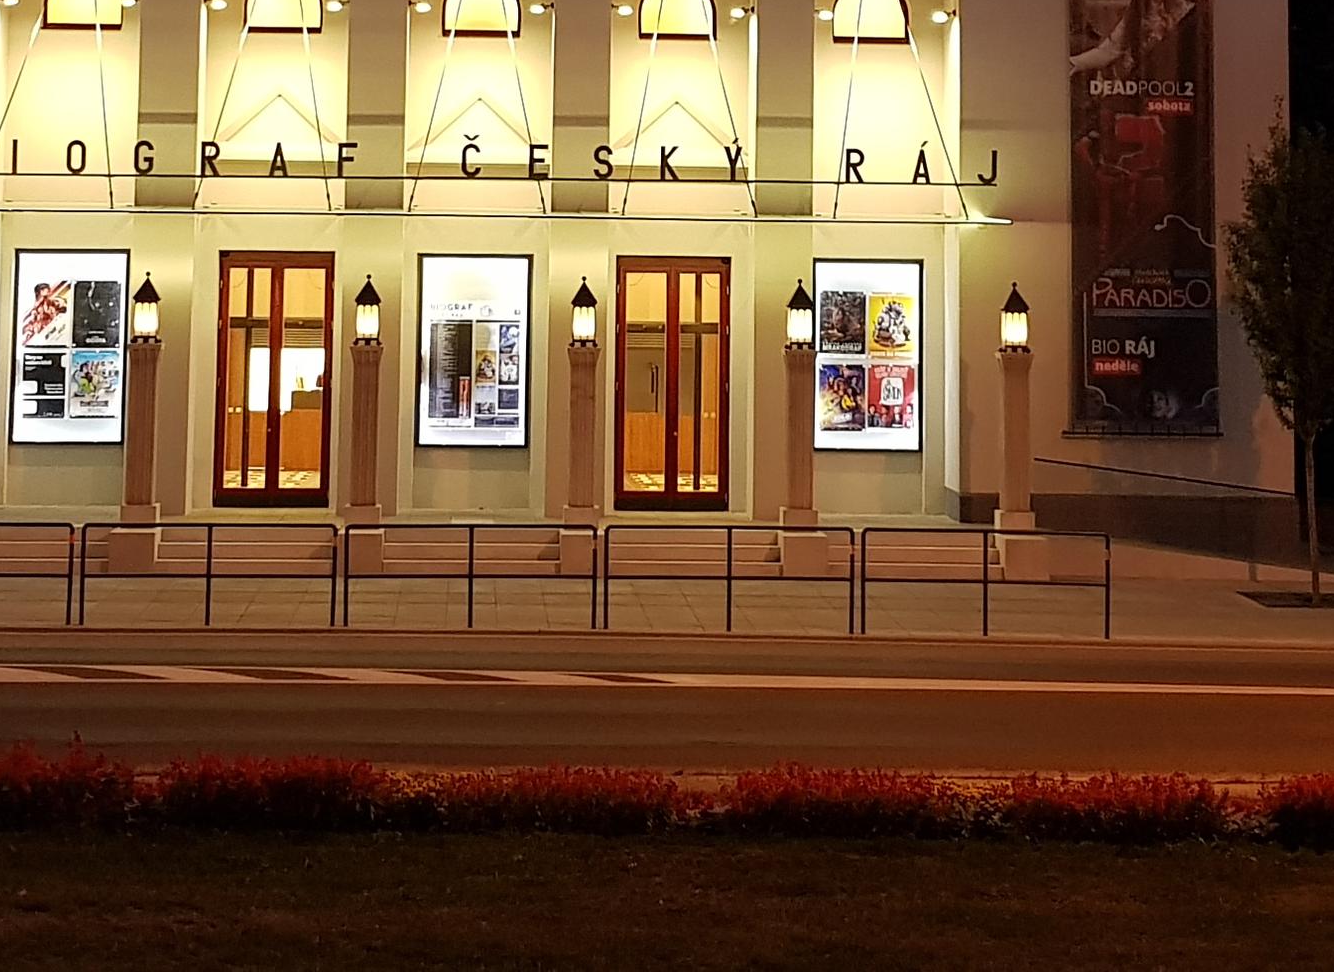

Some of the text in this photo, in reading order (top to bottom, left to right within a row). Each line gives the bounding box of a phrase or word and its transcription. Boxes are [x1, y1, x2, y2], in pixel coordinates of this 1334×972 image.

[1147, 98, 1192, 112] sobota
[461, 134, 743, 181] ČESKÝ
[845, 140, 997, 185] RÁJ
[1092, 277, 1212, 308] PARADISO
[1091, 335, 1156, 359] BIO RÁJ
[1095, 360, 1139, 372] neděle
